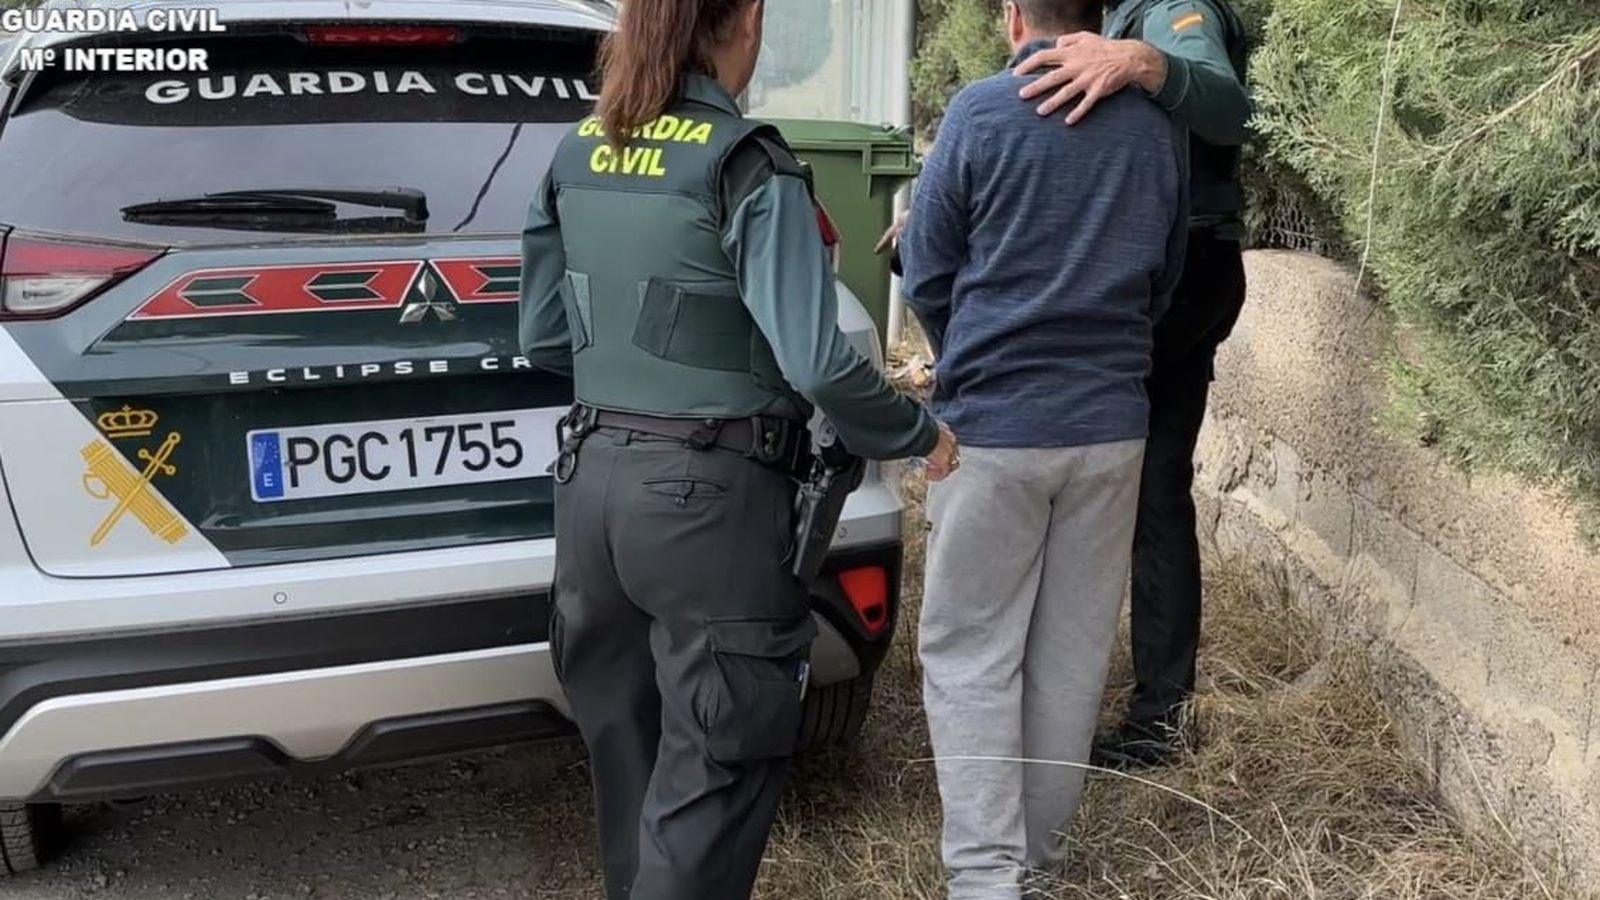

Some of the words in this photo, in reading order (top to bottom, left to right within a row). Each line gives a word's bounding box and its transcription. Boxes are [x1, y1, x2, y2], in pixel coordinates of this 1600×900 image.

[145, 71, 436, 104] GUARDIA
[454, 73, 600, 101] CIVIL
[590, 144, 667, 176] CIVIL
[229, 359, 448, 384] ECLIPSE
[263, 473, 273, 488] E
